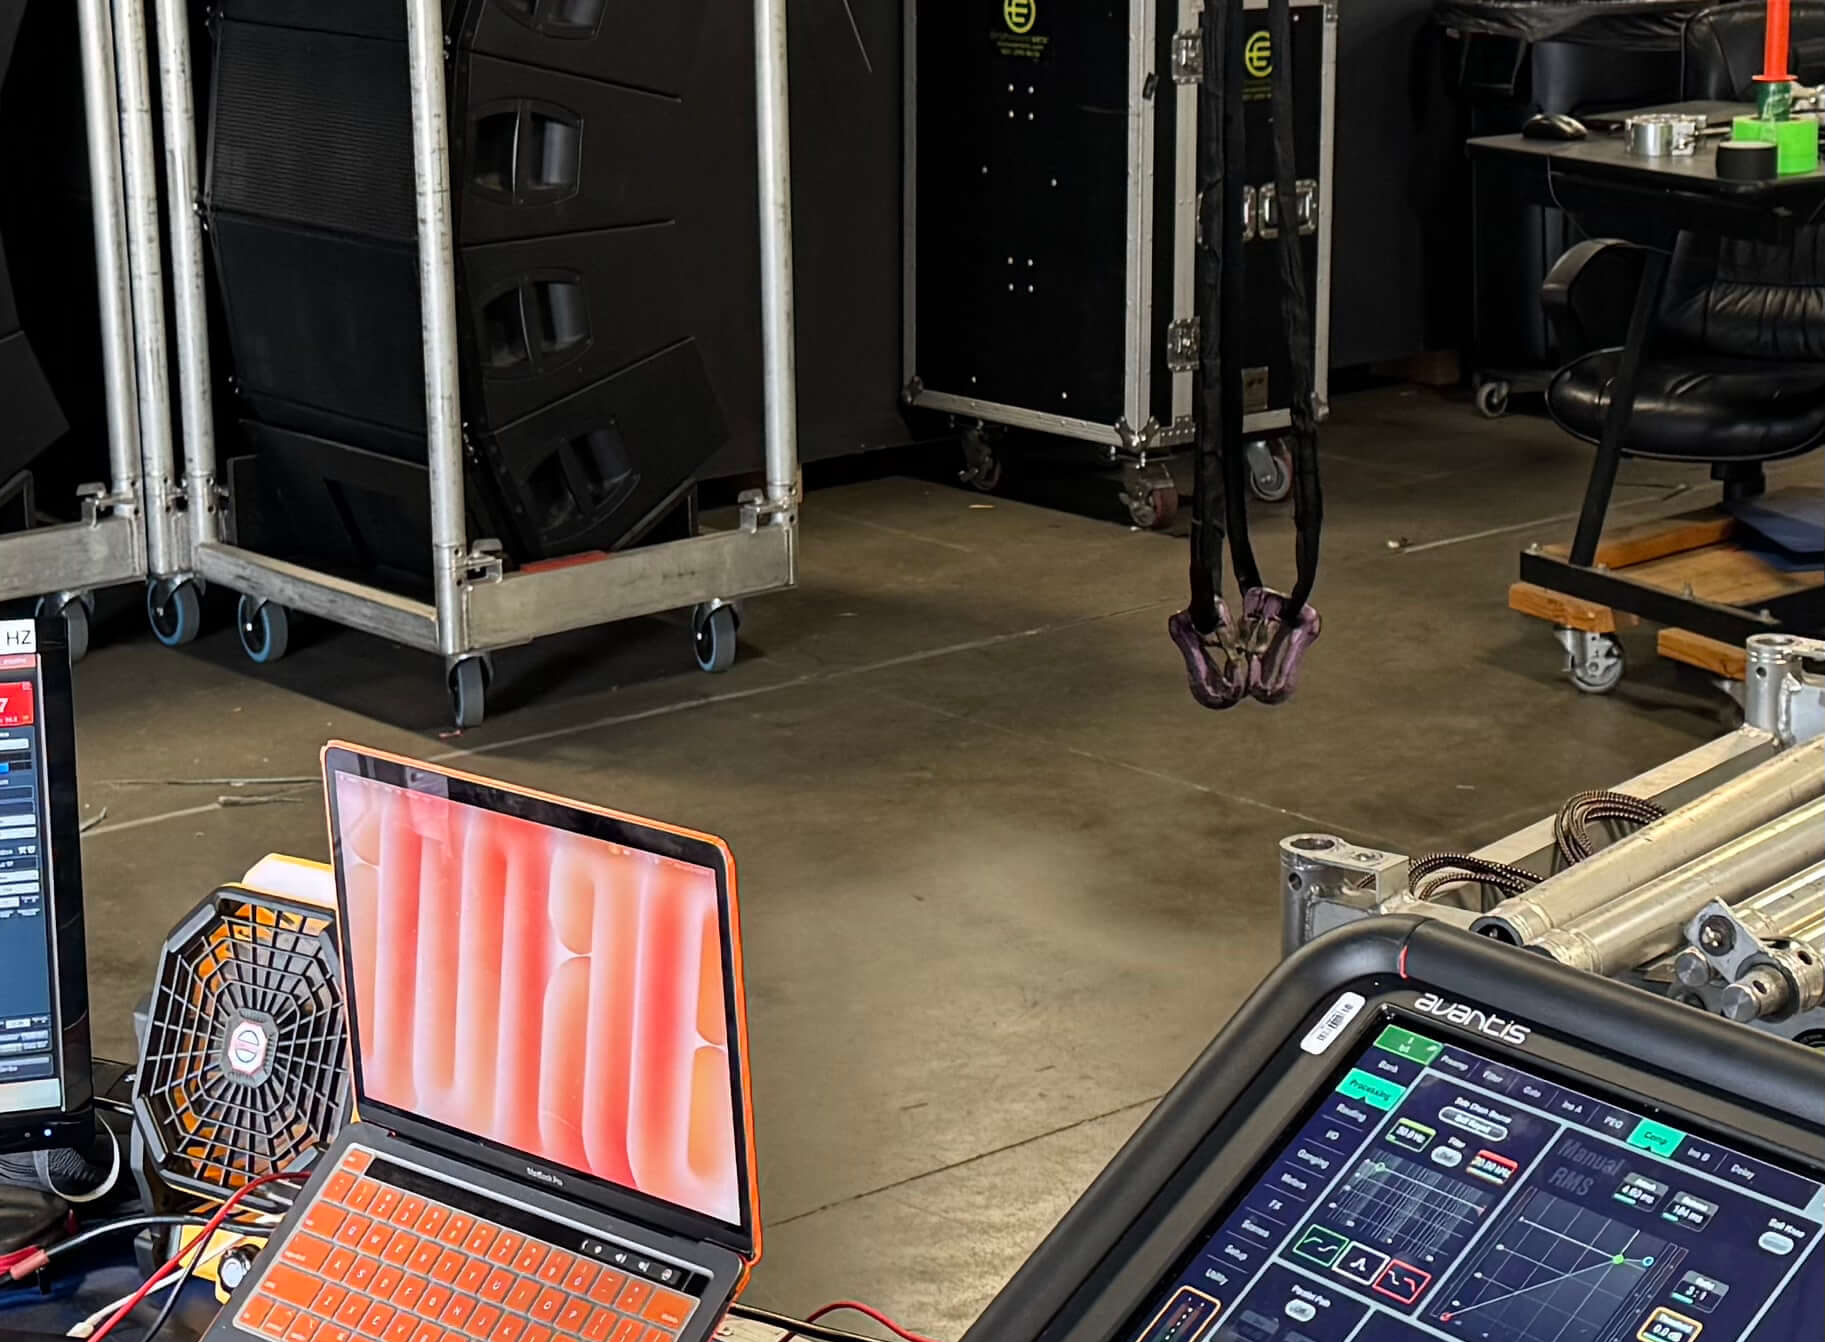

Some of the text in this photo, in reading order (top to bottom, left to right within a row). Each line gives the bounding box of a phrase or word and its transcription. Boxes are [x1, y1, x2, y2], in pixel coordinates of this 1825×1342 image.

[6, 630, 32, 646] HZ
[1415, 991, 1531, 1046] avantis
[1557, 1138, 1626, 1177] Manual
[1547, 1166, 1595, 1197] RMS
